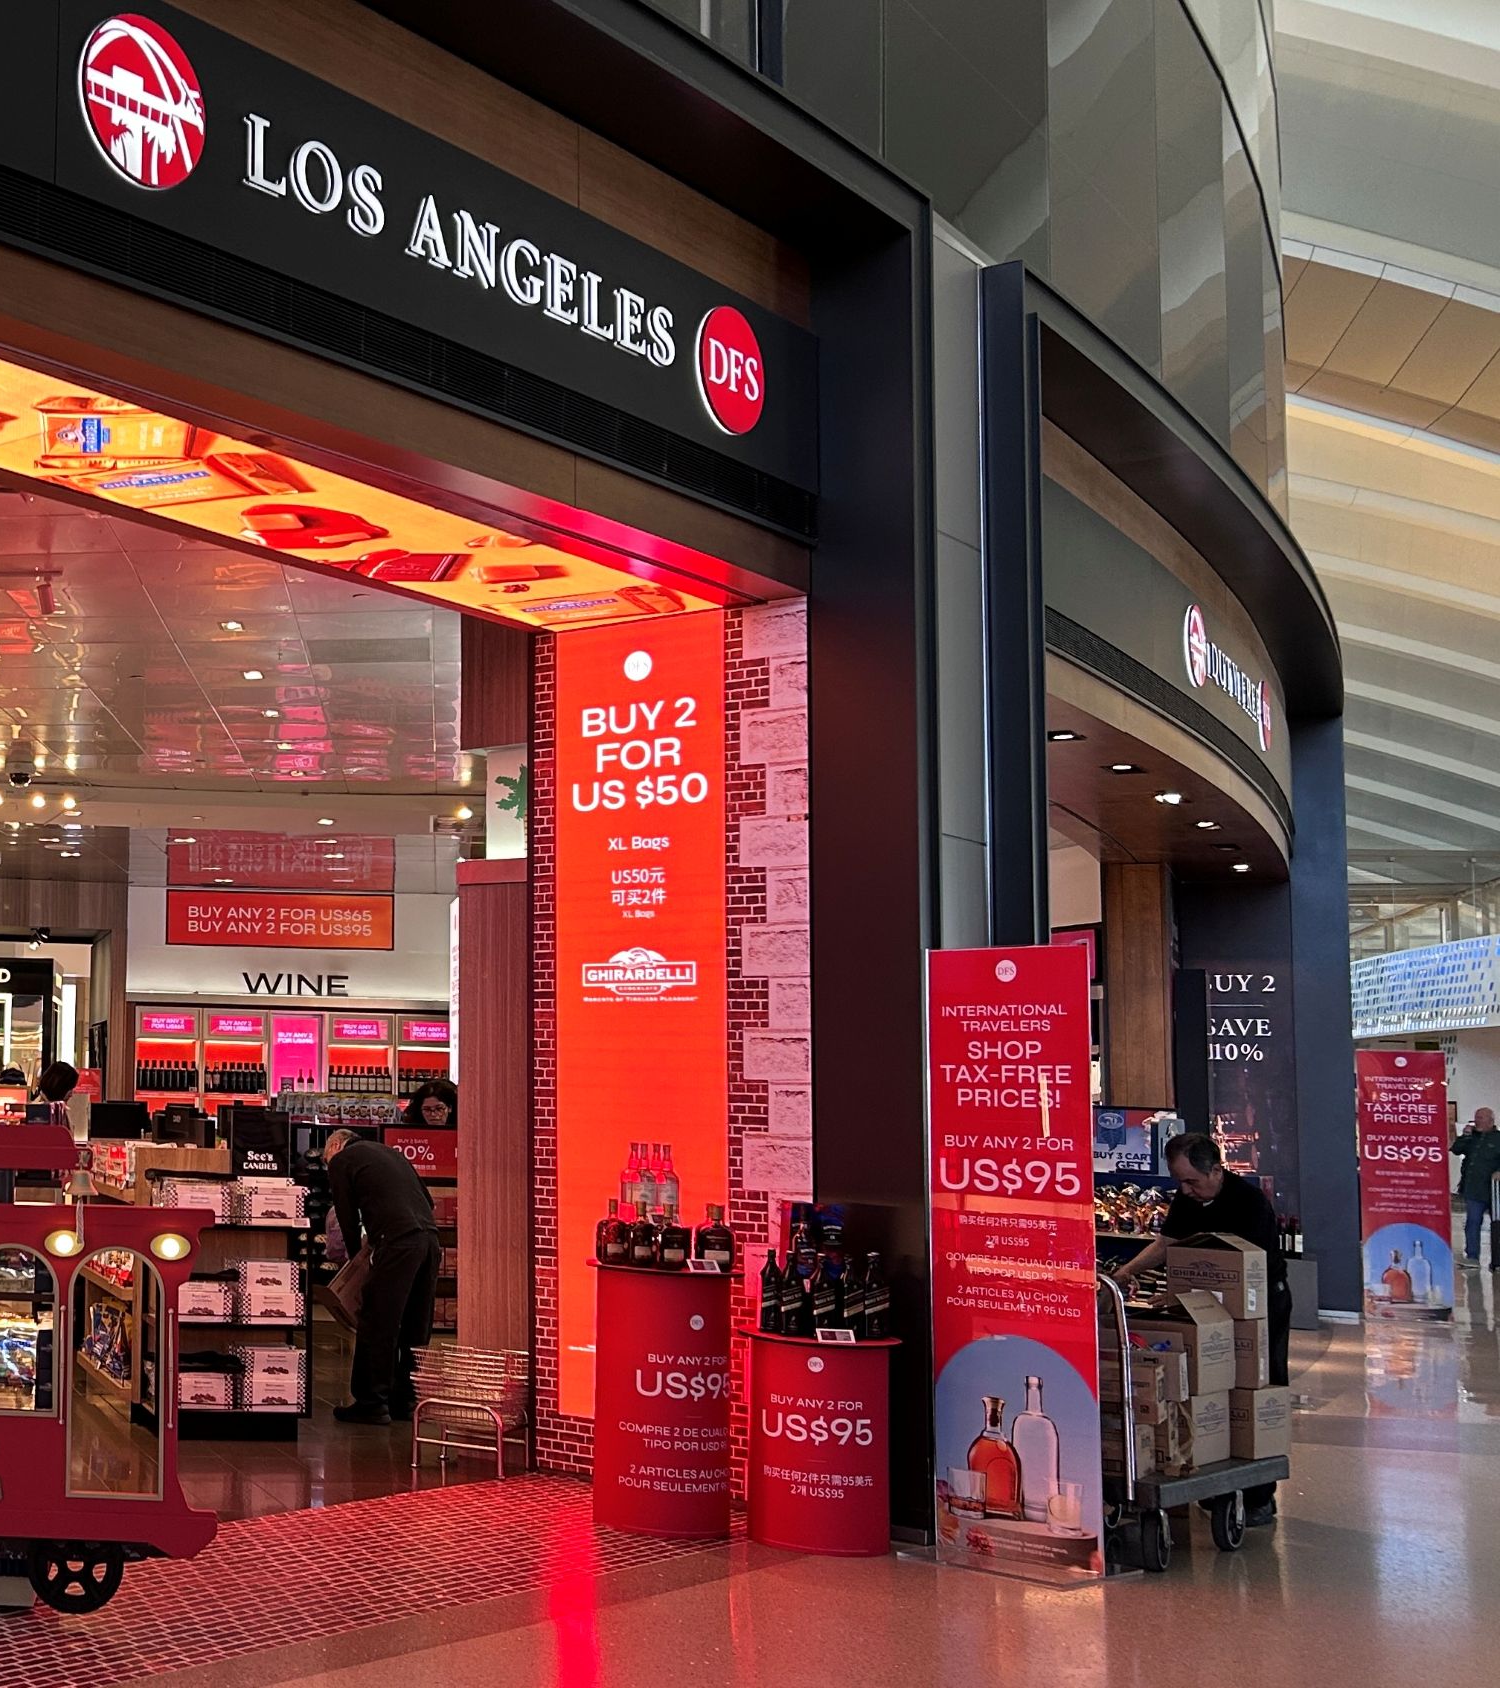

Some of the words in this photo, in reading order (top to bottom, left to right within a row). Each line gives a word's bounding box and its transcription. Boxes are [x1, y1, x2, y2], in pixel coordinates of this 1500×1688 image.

[243, 112, 386, 238] LOS
[406, 194, 677, 370] ANGELES
[707, 335, 761, 403] DFS
[581, 700, 665, 737] BUY
[674, 697, 697, 728] 2
[596, 737, 681, 773] FOR
[573, 780, 625, 812] US
[635, 772, 708, 809] $50
[608, 837, 628, 851] XL
[631, 836, 670, 852] Bags
[611, 867, 665, 884] US50元
[611, 888, 666, 905] 可买2件
[188, 906, 223, 918] BUY
[227, 907, 263, 919] ANY
[267, 908, 275, 919] 2
[280, 909, 316, 920] FOR
[320, 909, 372, 921] US$65
[188, 921, 223, 932] BUY
[227, 922, 263, 934] ANY
[267, 923, 275, 934] 2
[280, 923, 316, 935] FOR
[320, 924, 372, 936] US$95
[587, 968, 691, 982] GHIRARDELLI
[997, 965, 1015, 977] DFS
[242, 972, 349, 996] WINE
[1209, 974, 1253, 992] UY
[1262, 975, 1276, 992] 2
[941, 1003, 1068, 1017] INTERNATIONAL
[960, 1019, 1051, 1033] TRAVELERS
[967, 1040, 1042, 1060] SHOP
[940, 1064, 1072, 1085] TAX-FREE
[957, 1088, 1061, 1109] PRICES!
[1379, 1093, 1422, 1102] SHOP
[1364, 1103, 1438, 1114] TAX-FREE
[1374, 1114, 1432, 1124] PRICES!
[944, 1135, 978, 1149] BUY
[982, 1136, 1018, 1150] ANY
[1022, 1137, 1032, 1150] 2
[1037, 1137, 1073, 1152] FOR
[1366, 1134, 1387, 1142] BUY
[247, 1150, 274, 1161] See's
[1094, 1151, 1115, 1159] BUY
[1364, 1144, 1443, 1163] US$95
[243, 1162, 278, 1171] CANDIES
[939, 1158, 1081, 1196] US$95
[965, 1286, 1015, 1298] ARTICLES
[1016, 1291, 1032, 1300] AU
[1033, 1292, 1069, 1304] CHOIX
[947, 1296, 976, 1308] POUR
[977, 1299, 1042, 1314] SEULEMENT
[1058, 1308, 1081, 1317] USD
[648, 1353, 674, 1364] BUY
[677, 1356, 702, 1366] ANY
[770, 1393, 794, 1405] BUY
[796, 1397, 824, 1409] ANY
[827, 1400, 834, 1410] 2
[837, 1401, 863, 1411] FOR
[619, 1421, 671, 1436] COMPRE
[683, 1427, 699, 1438] DE
[762, 1408, 873, 1446] US$95
[643, 1438, 671, 1450] TIPO
[674, 1441, 699, 1451] POR
[700, 1441, 720, 1451] USD
[639, 1466, 697, 1479] ARTICLES
[699, 1469, 713, 1479] AU
[618, 1476, 650, 1489] POUR
[652, 1480, 720, 1493] SEULEMENT
[809, 1487, 845, 1499] US$95
